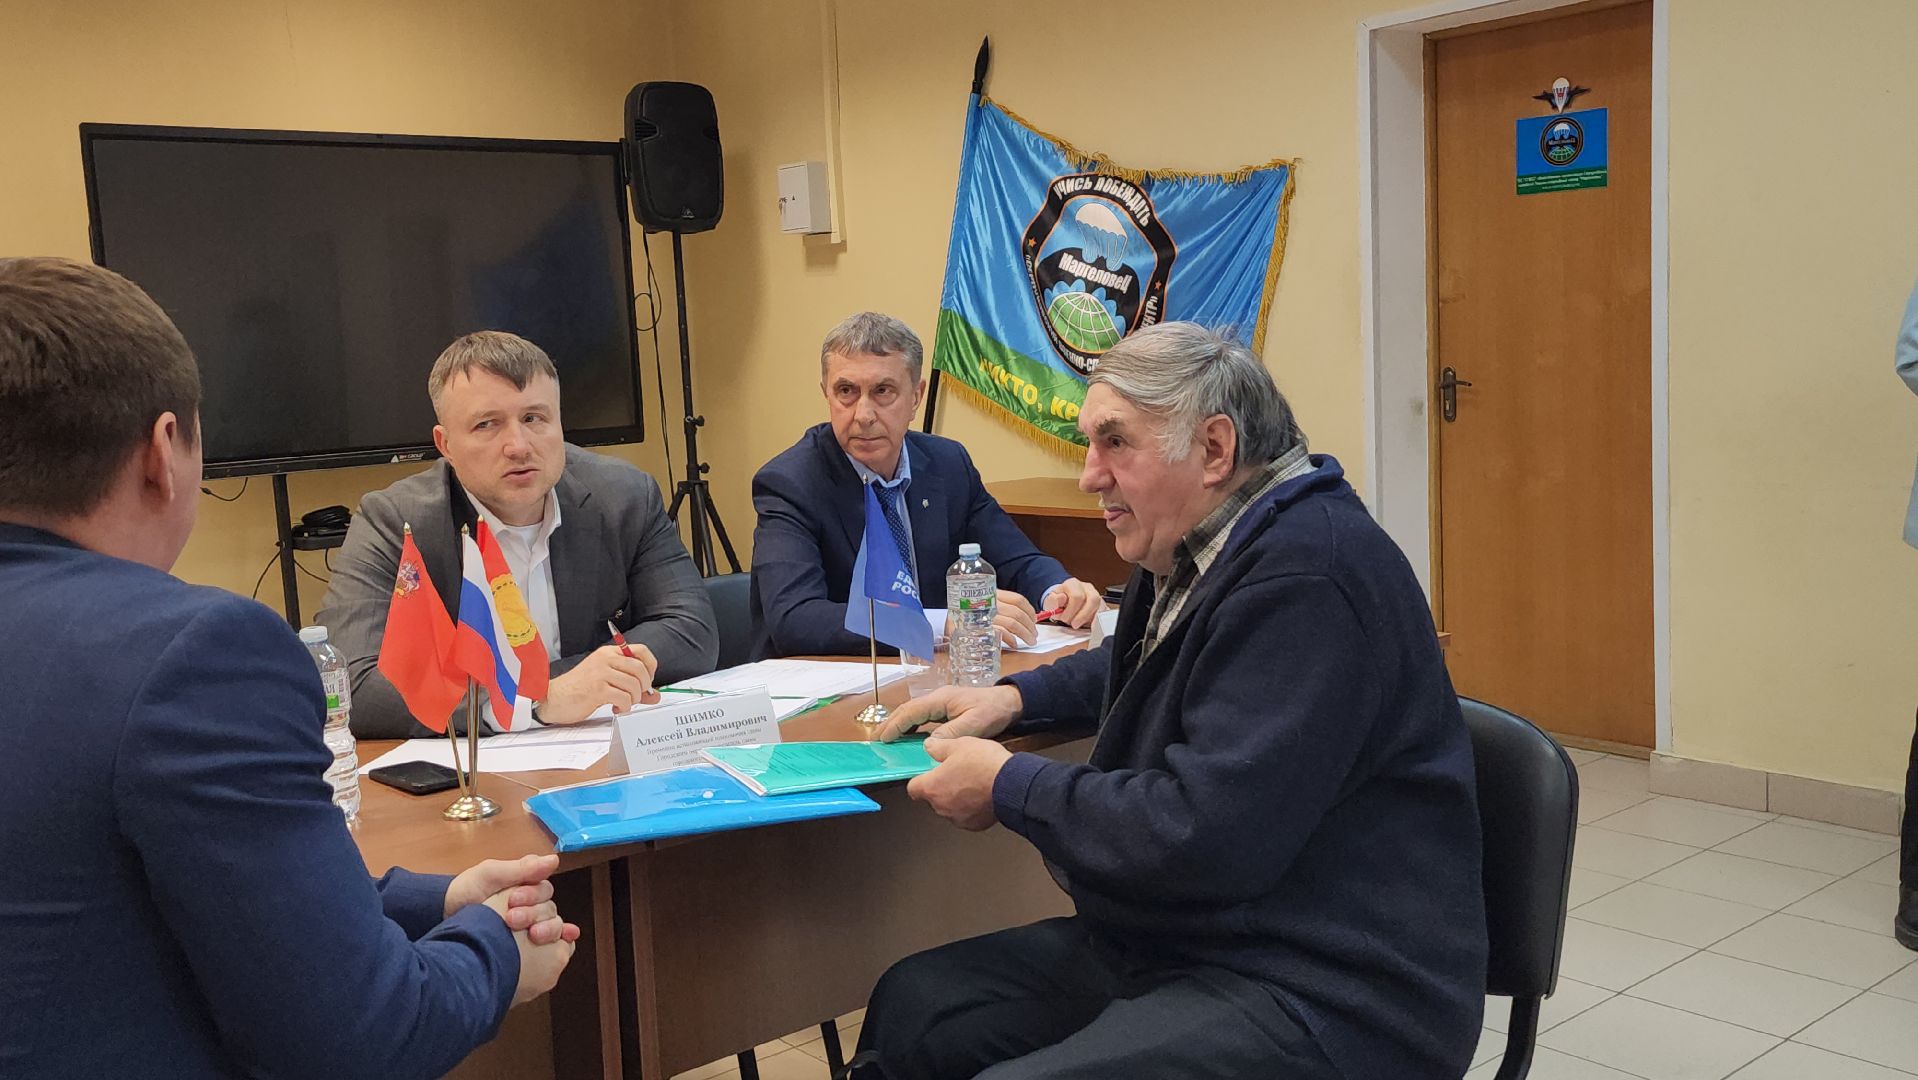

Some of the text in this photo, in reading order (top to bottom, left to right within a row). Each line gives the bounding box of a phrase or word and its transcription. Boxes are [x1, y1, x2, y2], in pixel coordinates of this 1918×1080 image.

[1053, 177, 1151, 227] УЧИСЬ ПОБЕЖДАТЬ
[1058, 252, 1133, 294] Маргеловец
[1050, 396, 1080, 420] КР
[891, 581, 920, 602] РОС
[636, 715, 768, 747] Алексей Владимирович
[675, 708, 725, 726] ШИМКО
